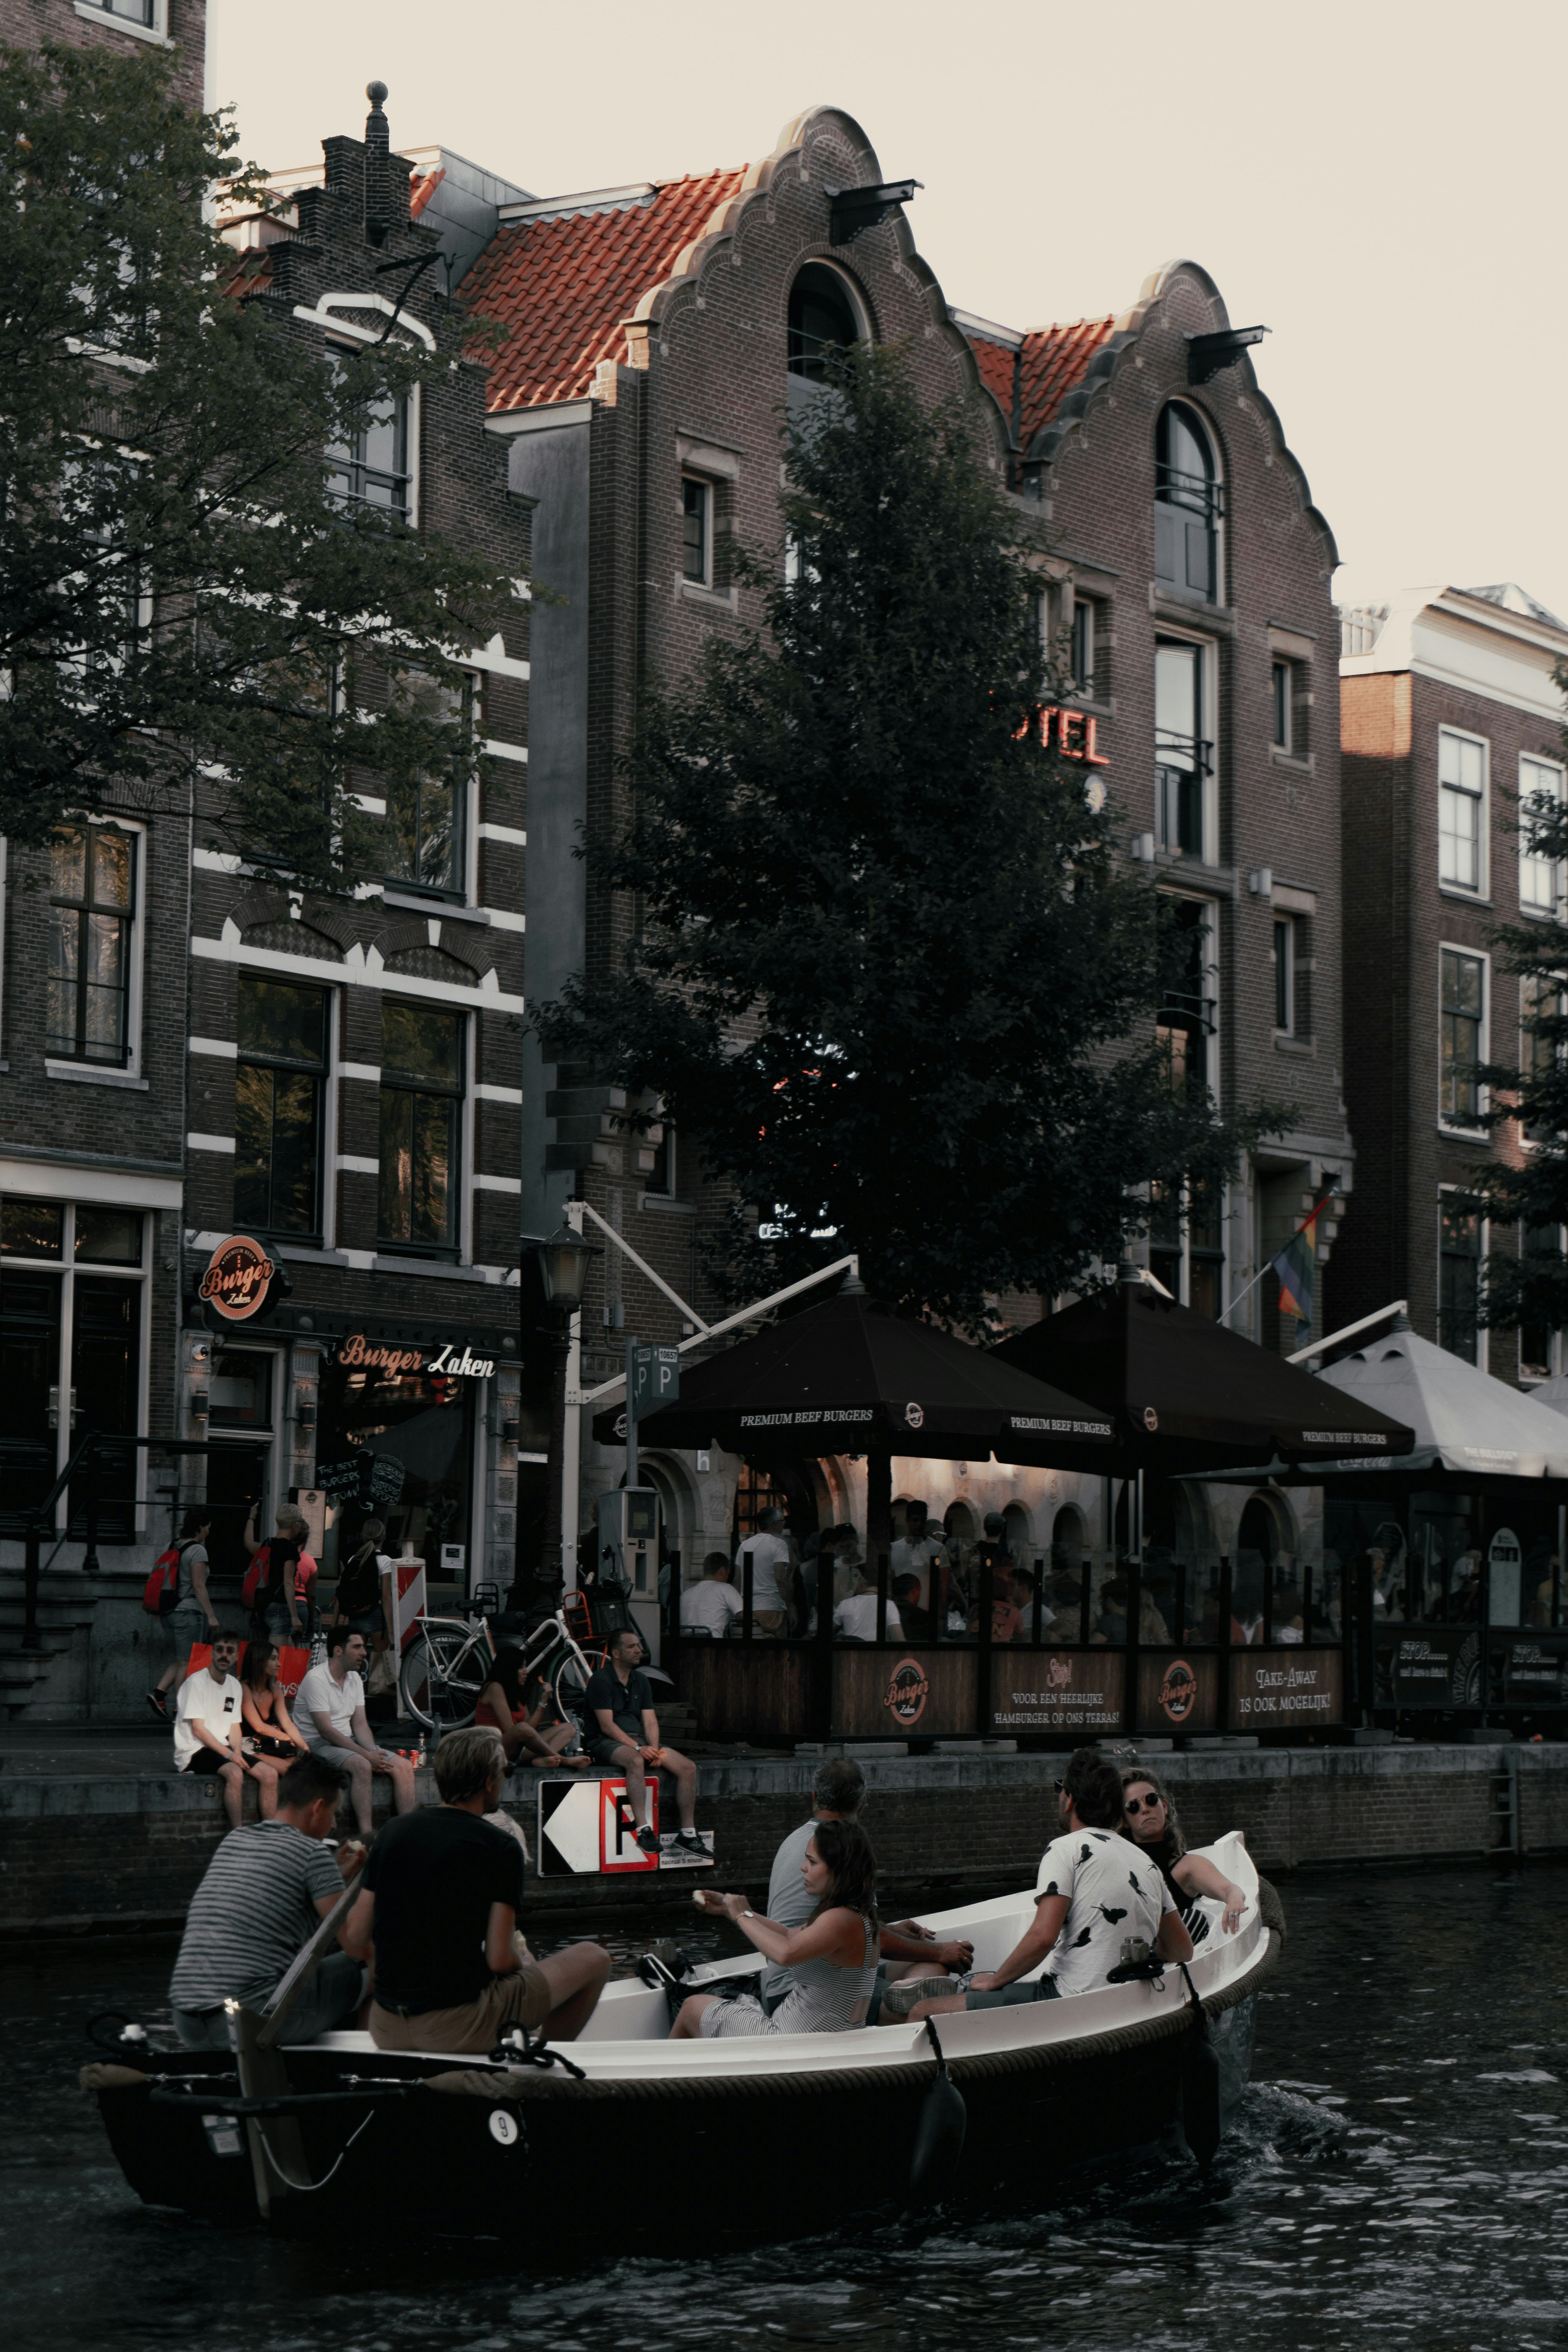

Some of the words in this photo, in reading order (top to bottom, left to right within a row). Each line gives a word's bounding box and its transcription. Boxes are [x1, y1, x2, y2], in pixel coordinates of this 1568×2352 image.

[224, 1249, 244, 1261] PREMIUM
[244, 1249, 255, 1259] BEEF
[201, 1261, 272, 1296] Burger
[226, 1293, 252, 1304] Zaken
[339, 1334, 423, 1379] Burger
[428, 1343, 495, 1378] Zaken
[660, 1350, 677, 1360] 10657
[639, 1367, 647, 1394] P
[660, 1366, 671, 1393] P
[740, 1414, 793, 1427] PREMIUM
[794, 1411, 822, 1423] BEEF
[823, 1410, 874, 1422] BURGERS
[1010, 1417, 1050, 1430] PREMIUM
[1051, 1419, 1072, 1432] BEEF
[1073, 1421, 1111, 1435] BURGERS
[1302, 1431, 1335, 1443] PREMIUM
[1334, 1432, 1352, 1443] BEEF
[1352, 1433, 1387, 1445] BURGERS
[316, 1465, 334, 1475] THE
[336, 1459, 359, 1470] BEST
[318, 1470, 361, 1488] BURGERS
[1047, 1658, 1073, 1688] Stop!
[884, 1680, 929, 1706] Burger
[1012, 1693, 1038, 1704] VOOR
[1040, 1693, 1058, 1704] EEN
[1059, 1693, 1104, 1706] HEERLIJKE
[1158, 1680, 1198, 1704] Burger
[899, 1704, 916, 1714] Zaken
[1239, 1698, 1251, 1713] IS
[1254, 1697, 1277, 1712] OOK
[1278, 1692, 1331, 1711] MOGELIJK!
[994, 1712, 1050, 1724] HAMBURGER
[1052, 1712, 1065, 1724] OP
[1066, 1711, 1084, 1723] ONS
[1085, 1711, 1120, 1723] TERRAS!
[498, 2117, 508, 2138] 9
